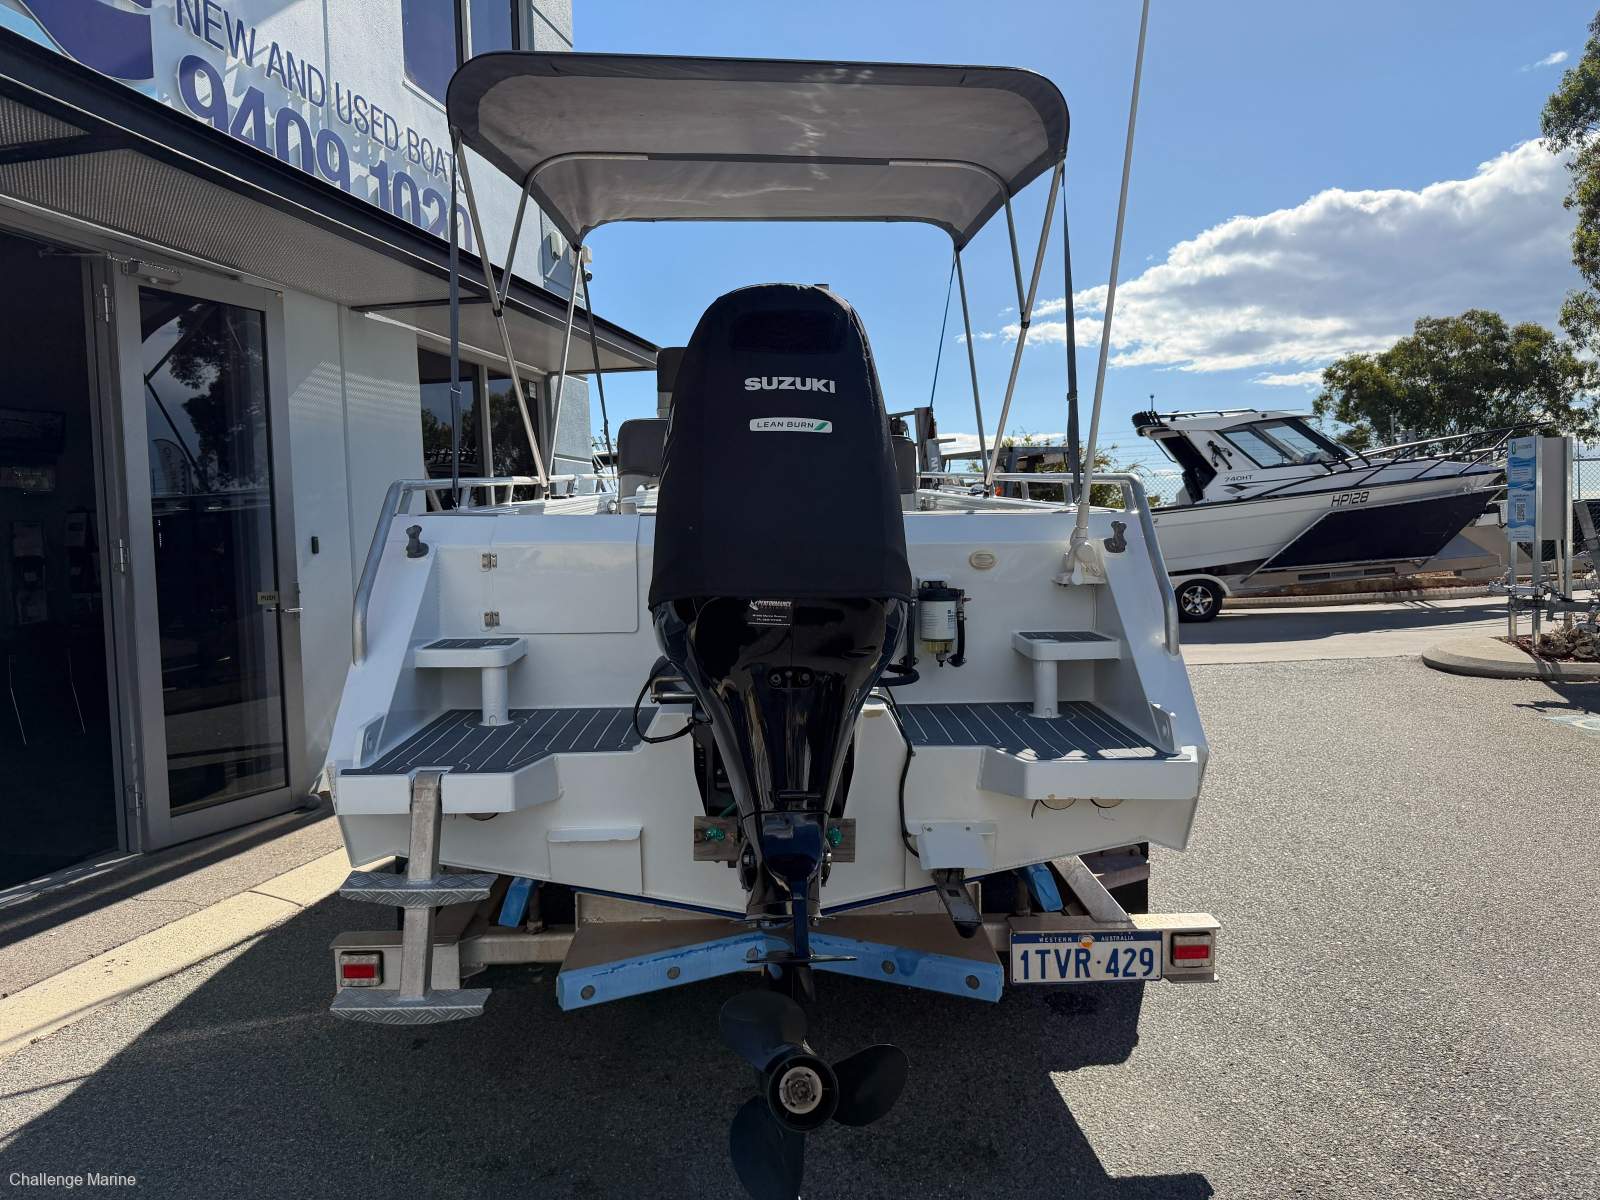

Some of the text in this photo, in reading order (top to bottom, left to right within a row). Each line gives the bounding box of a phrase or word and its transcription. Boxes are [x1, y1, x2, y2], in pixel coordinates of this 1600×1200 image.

[177, 0, 256, 67] NEW
[265, 41, 325, 107] AND
[335, 81, 399, 151] USED
[178, 54, 350, 192] 9409
[744, 376, 836, 394] SUZUKI
[757, 421, 815, 429] LEAN BURN
[1331, 491, 1370, 506] HP128
